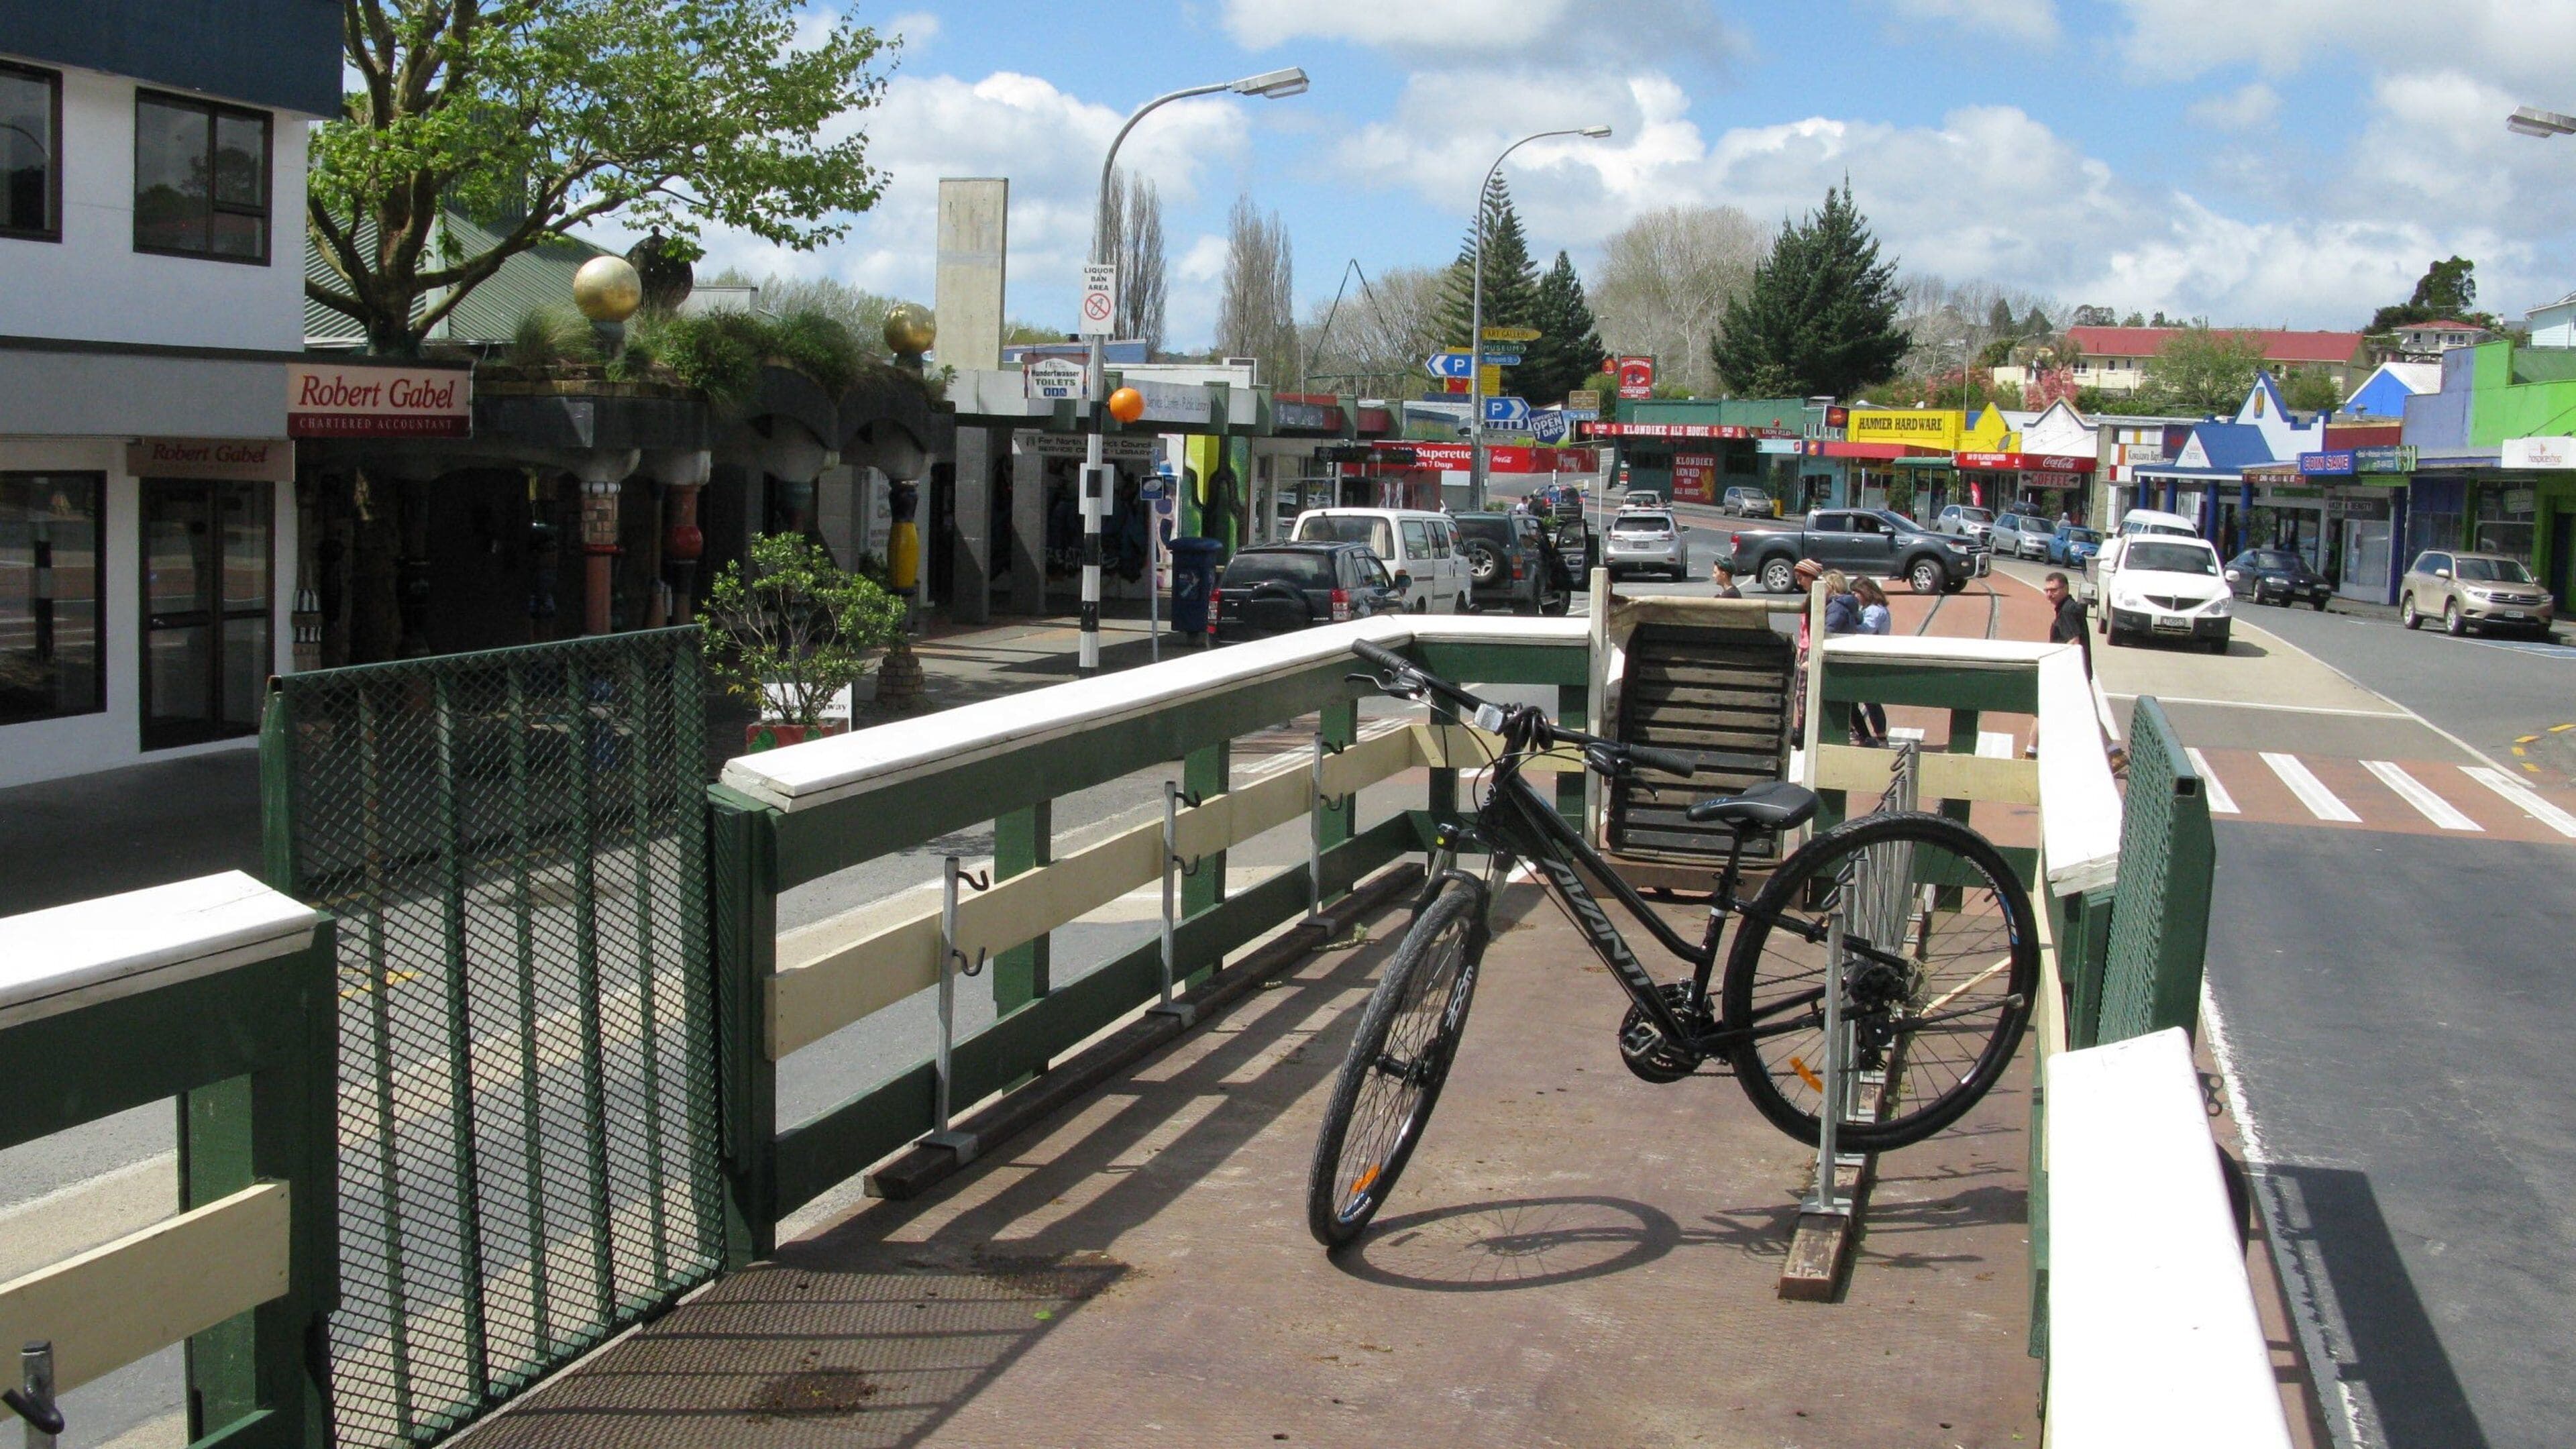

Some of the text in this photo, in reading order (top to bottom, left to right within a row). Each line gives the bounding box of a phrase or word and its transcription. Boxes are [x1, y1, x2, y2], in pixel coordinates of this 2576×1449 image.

[1454, 359, 1465, 372] P
[1035, 378, 1076, 386] TOILETS
[299, 374, 455, 409] Robert Gabel
[1492, 403, 1502, 415] P
[300, 417, 451, 431] CHARTERED ACCOUNTANT
[1533, 416, 1562, 432] OPEN
[1623, 424, 1709, 436] KLONDIKE ALE HOUSE
[1859, 417, 1943, 431] HAMMER HARDWARE
[1536, 425, 1565, 439] 7 DAYS
[1121, 440, 1151, 448] Council
[152, 443, 268, 463] Robert Gabel
[1416, 447, 1472, 460] Superette
[1434, 460, 1454, 469] Days
[1676, 456, 1714, 466] KLONDIKE
[2304, 455, 2348, 470] COIN SAVE
[1676, 468, 1700, 477] LION RED
[2032, 473, 2069, 485] COFFEE
[1542, 857, 1650, 986] AVANTI
